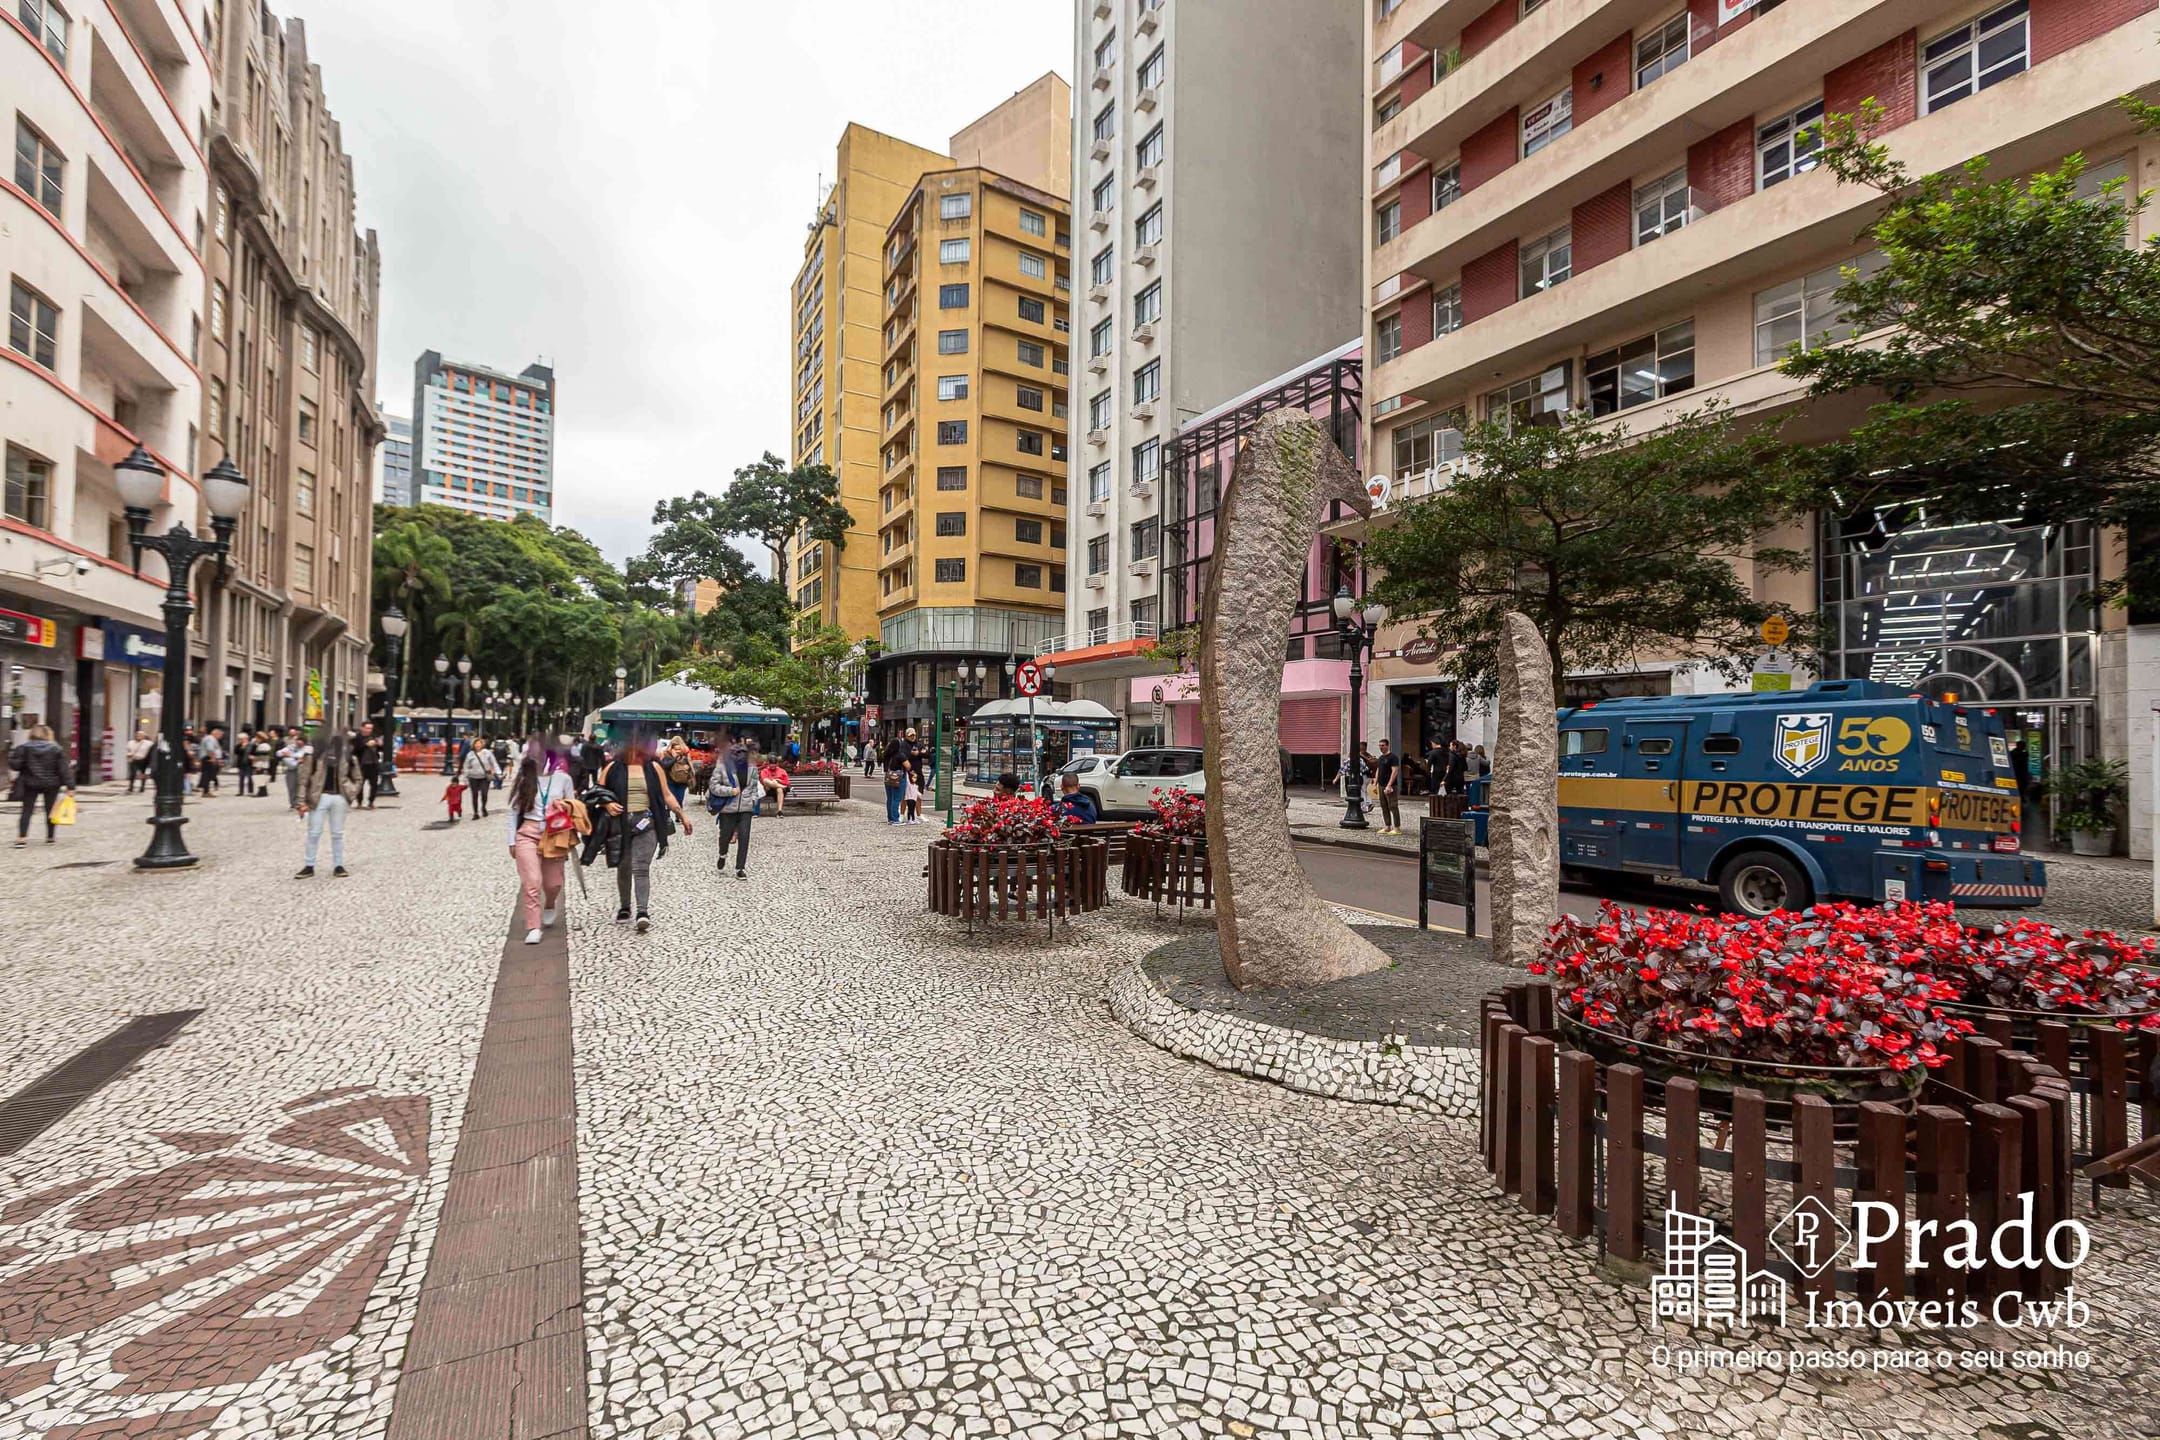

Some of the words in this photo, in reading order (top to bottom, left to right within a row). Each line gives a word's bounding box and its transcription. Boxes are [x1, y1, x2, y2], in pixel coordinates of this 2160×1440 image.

[1784, 736, 1820, 750] PROTEGE
[1838, 759, 1900, 772] ANOS
[1693, 783, 1916, 822] PROTEGE
[1939, 790, 2011, 824] PROTEGE
[1691, 814, 1724, 824] PROTEGE
[1725, 816, 1739, 825] S/A
[1744, 817, 1787, 828] PROTEÇÃO
[1788, 820, 1795, 828] E
[1795, 821, 1852, 832] TRANSPORTE
[1853, 825, 1867, 833] DE
[1867, 826, 1911, 836] VALORES
